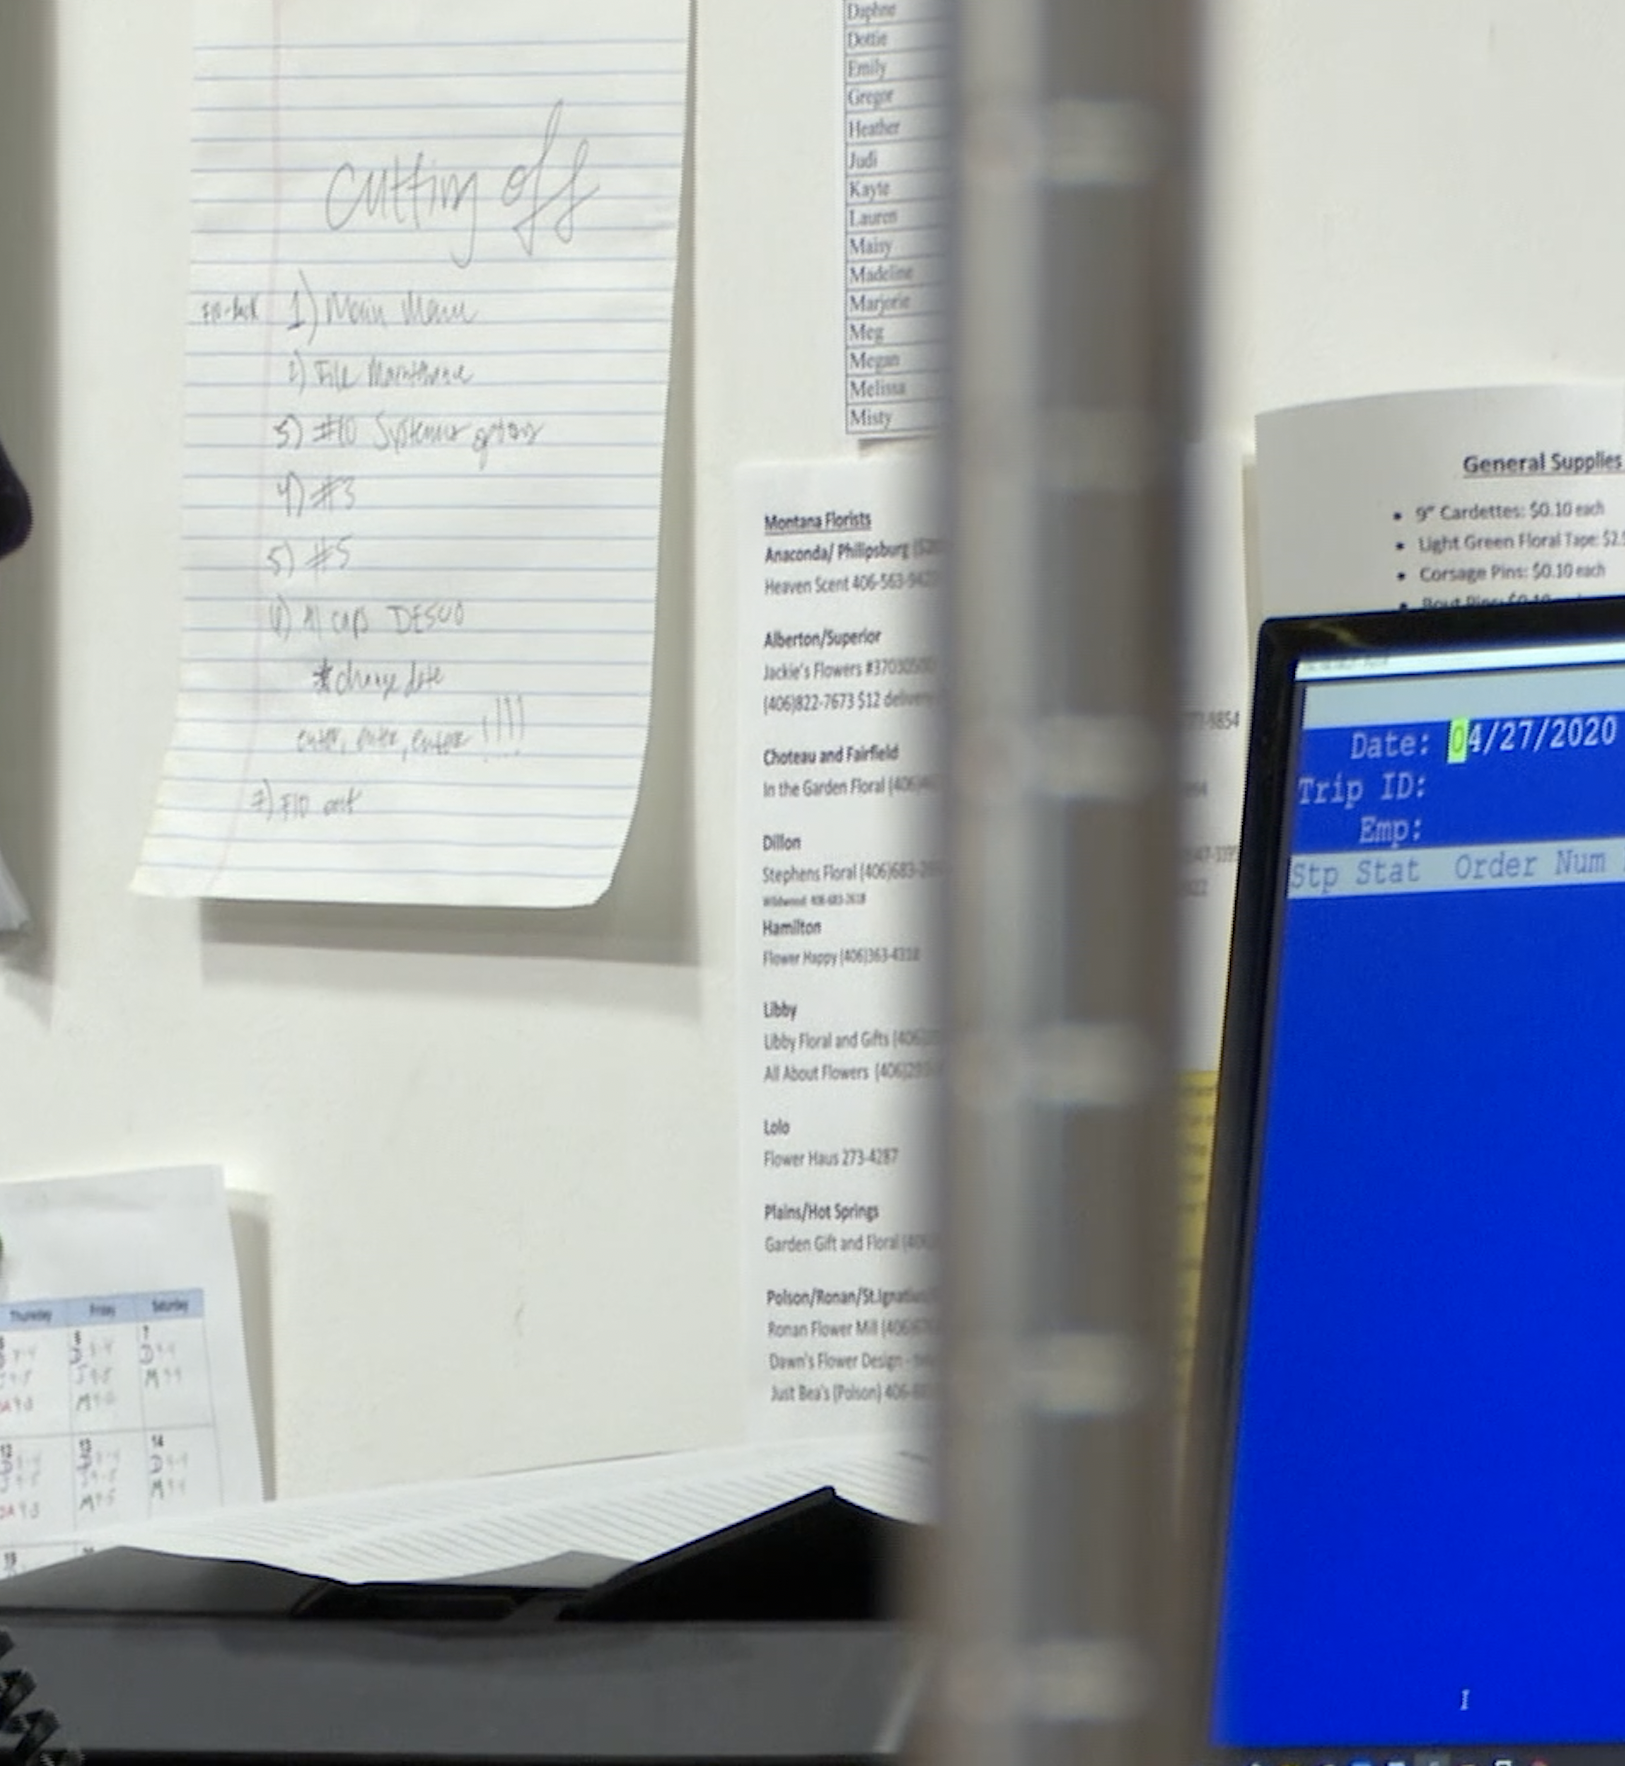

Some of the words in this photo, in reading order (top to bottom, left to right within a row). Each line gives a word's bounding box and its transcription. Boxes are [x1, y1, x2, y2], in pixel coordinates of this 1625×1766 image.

[848, 58, 886, 80] Emily
[848, 89, 894, 109] Gregor
[848, 119, 900, 138] Heather
[848, 151, 877, 169] Judi
[849, 181, 890, 203] Kayte
[850, 209, 898, 228] Lauren
[850, 265, 913, 284] Madeline
[288, 269, 317, 346] 1)
[850, 294, 910, 316] Marjorie
[850, 323, 884, 346] Meg
[850, 352, 900, 374] Megan
[850, 379, 906, 398] Melissa
[850, 409, 892, 429] Misty
[1463, 453, 1547, 474] General
[1551, 451, 1623, 473] Supplies
[764, 514, 822, 530] Montana
[825, 510, 871, 528] Florists
[1440, 503, 1526, 522] Cardettes:
[1529, 501, 1573, 520] $0.10
[1575, 501, 1605, 517] each
[1419, 536, 1459, 555] Light
[1463, 533, 1514, 552] Green
[1518, 531, 1561, 549] Floral
[1563, 530, 1600, 552] Tape:
[267, 538, 294, 578] 5)
[765, 543, 834, 564] Anaconda/
[1420, 564, 1487, 584] Corsage
[1491, 564, 1528, 581] Pins:
[1532, 562, 1573, 581] $0.10
[1575, 564, 1606, 579] each
[764, 578, 812, 595] Heaven
[816, 576, 849, 593] Scent
[763, 628, 882, 649] Alberton/Superior
[763, 662, 810, 681] Jackie's
[814, 662, 862, 679] Flowers
[763, 693, 854, 715] (406)822-7673
[858, 691, 880, 709] $12
[1350, 730, 1431, 760] Date:
[1449, 715, 1618, 756] 04/27/2020
[763, 748, 817, 766] Choteau
[820, 747, 843, 765] and
[846, 744, 900, 762] Fairfield
[763, 781, 775, 798] In
[779, 780, 800, 798] the
[803, 778, 848, 798] Garden
[851, 777, 885, 794] Floral
[1299, 775, 1364, 813] Trip
[1380, 772, 1427, 802] ID:
[762, 834, 802, 851] Dillon
[1359, 816, 1422, 848] Emp:
[763, 866, 821, 886] Stephens
[823, 864, 857, 881] Floral
[1290, 861, 1338, 894] Stp
[1356, 858, 1421, 886] Stat
[1455, 852, 1538, 881] Order
[1555, 849, 1607, 876] Num
[762, 919, 822, 936] Hamilton
[763, 949, 800, 967] Flower
[803, 948, 837, 967] Happy
[763, 1001, 797, 1022] Libby
[764, 1033, 796, 1053] Libby
[799, 1032, 832, 1050] Floral
[835, 1031, 858, 1049] and
[861, 1029, 889, 1049] Gifts
[763, 1065, 780, 1082] All
[783, 1064, 819, 1081] About
[821, 1064, 869, 1081] Flowers
[763, 1118, 790, 1136] Lolo
[764, 1150, 805, 1168] Flower
[808, 1149, 839, 1167] Haus
[765, 1202, 831, 1223] Plains/Hot
[834, 1203, 879, 1223] Springs
[765, 1236, 811, 1253] Garden
[814, 1235, 838, 1252] Gift
[840, 1235, 863, 1251] and
[867, 1234, 900, 1250] Floral
[9, 1309, 53, 1324] Thursday
[89, 1304, 116, 1319] Friday
[152, 1298, 189, 1314] Saturday
[767, 1321, 808, 1339] Ronan
[811, 1319, 853, 1338] Flower
[856, 1319, 878, 1337] Mill
[769, 1352, 814, 1371] Dawn's
[817, 1352, 858, 1369] Flower
[861, 1352, 903, 1372] Design
[771, 1385, 795, 1402] Just
[833, 1384, 882, 1404] (Polson)
[152, 1434, 164, 1449] 14
